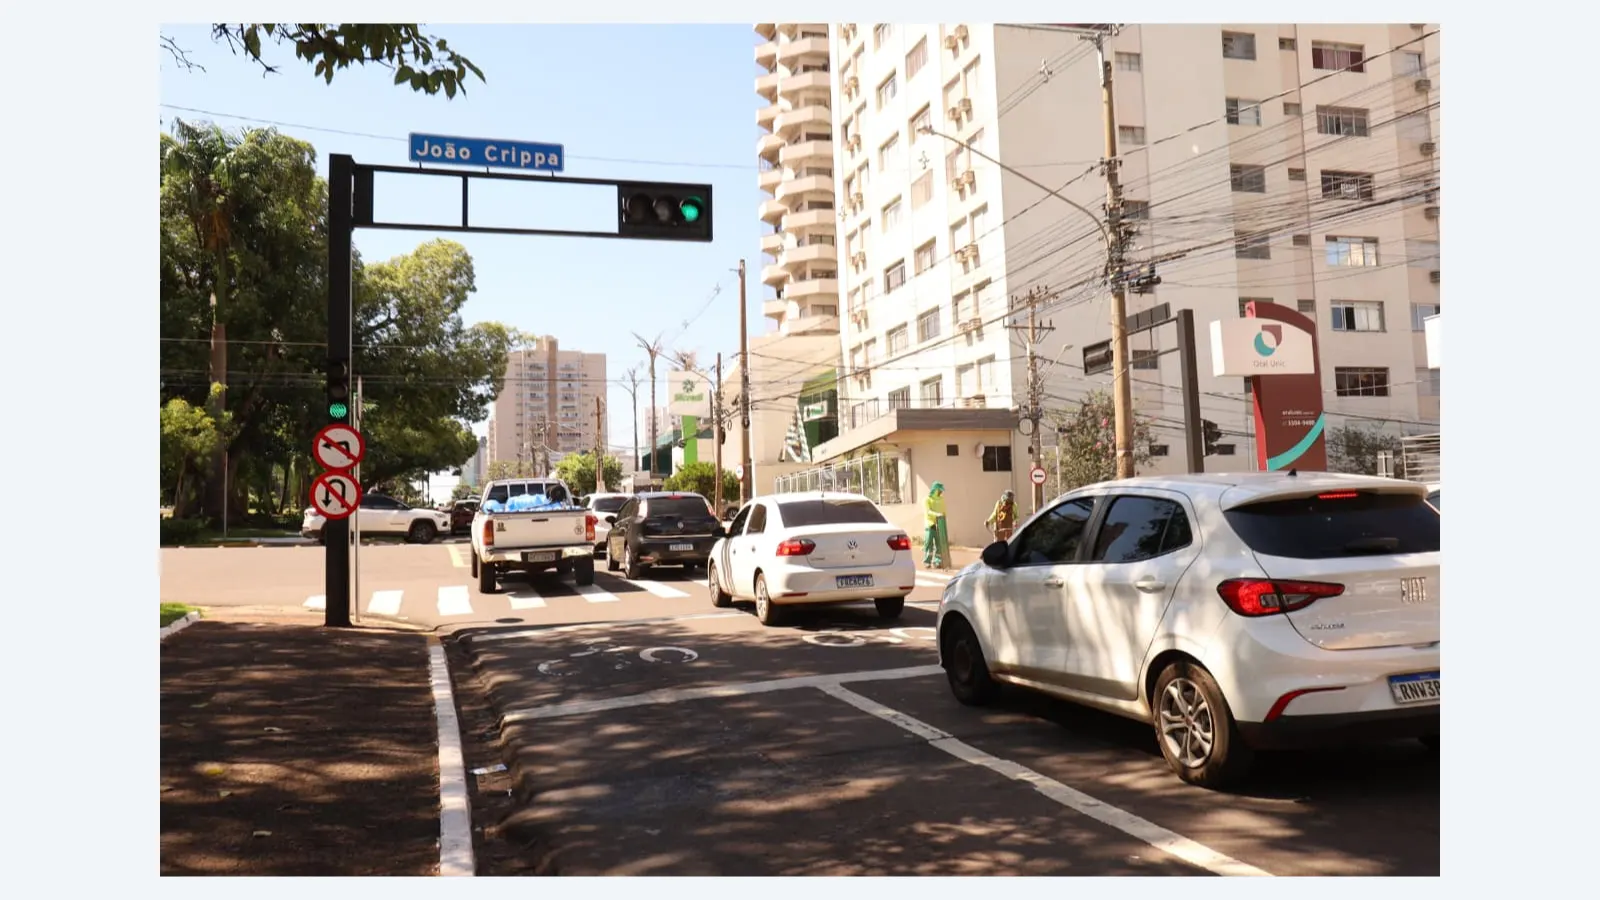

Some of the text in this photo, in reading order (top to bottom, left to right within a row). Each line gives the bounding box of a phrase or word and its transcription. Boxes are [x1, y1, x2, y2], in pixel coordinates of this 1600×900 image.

[416, 140, 559, 168] João Crippa
[1400, 576, 1427, 604] FIAT
